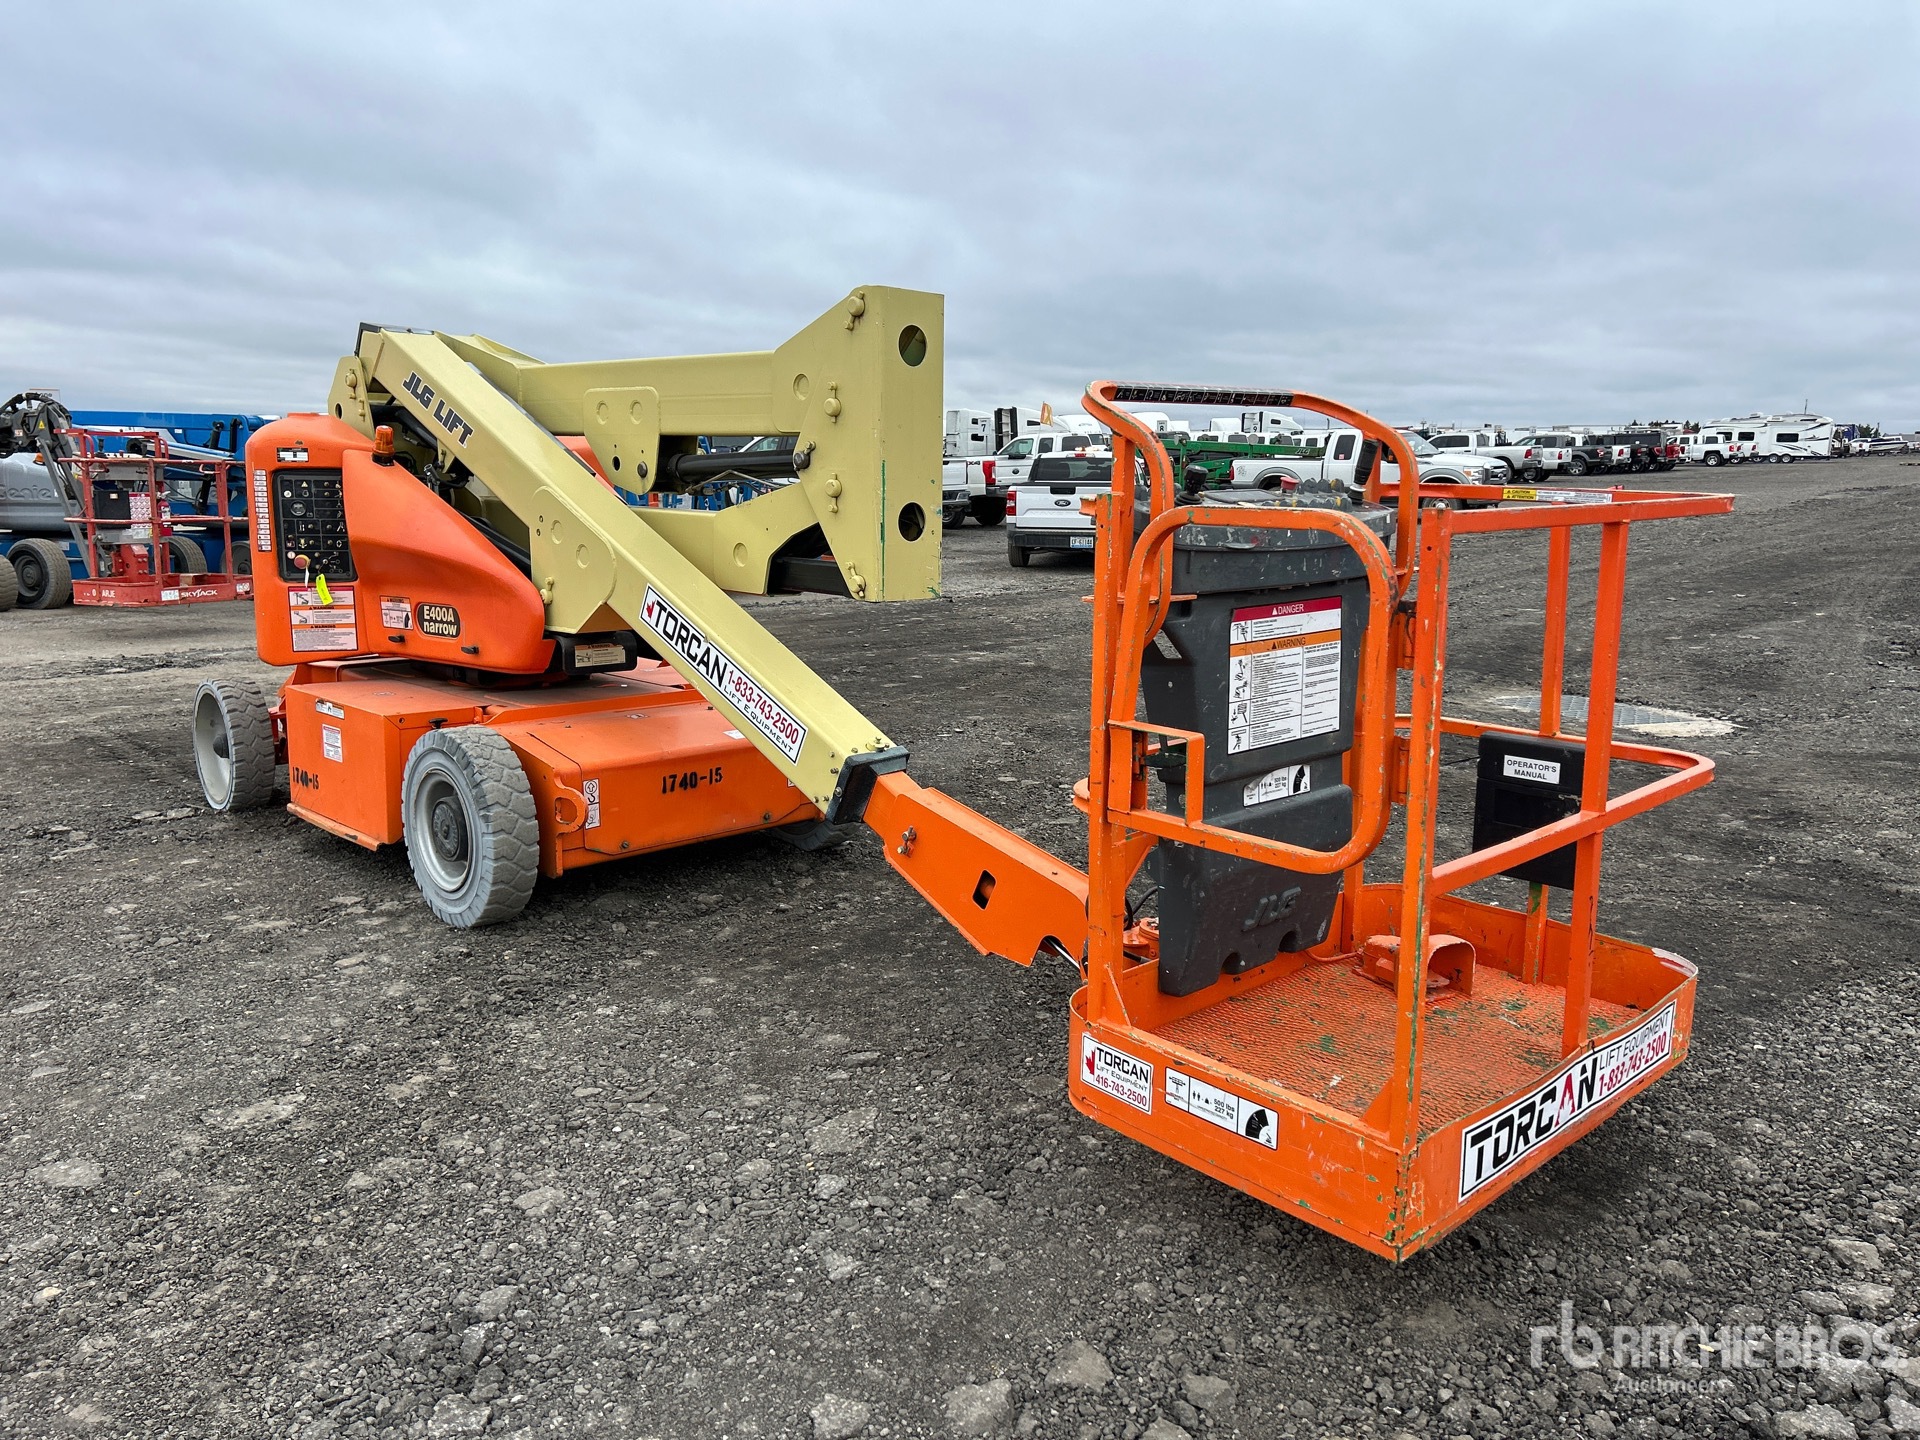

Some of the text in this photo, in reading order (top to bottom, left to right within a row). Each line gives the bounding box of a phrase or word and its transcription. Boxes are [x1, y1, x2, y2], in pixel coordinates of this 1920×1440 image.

[402, 371, 474, 446] JLG LIFT
[181, 588, 218, 598] SKYJACK
[423, 605, 455, 623] E400A
[1277, 603, 1305, 615] DANGER
[423, 621, 458, 636] narrow
[655, 601, 728, 688] TORCAN
[1276, 636, 1307, 650] WARNING
[723, 684, 794, 754] LIFT EQUIPMENT
[728, 669, 799, 745] 1-833-743-2500
[292, 766, 319, 790] 1740-15
[1506, 759, 1557, 773] OPERATOR'S
[1513, 768, 1548, 780] MANUAL
[661, 767, 723, 794] 1740-15
[1599, 1010, 1670, 1071] LIFT EQUIPMENT
[1096, 1046, 1149, 1084] TORCAN
[1096, 1063, 1148, 1092] LIFT EQUIPMENT
[1599, 1031, 1667, 1097] 1-833-743-2500
[1095, 1074, 1148, 1107] 416-743-2500
[1213, 1098, 1235, 1112] 500 lbs
[1214, 1105, 1225, 1113] 227
[1226, 1111, 1234, 1120] kg
[1470, 1056, 1598, 1182] TORCAN
